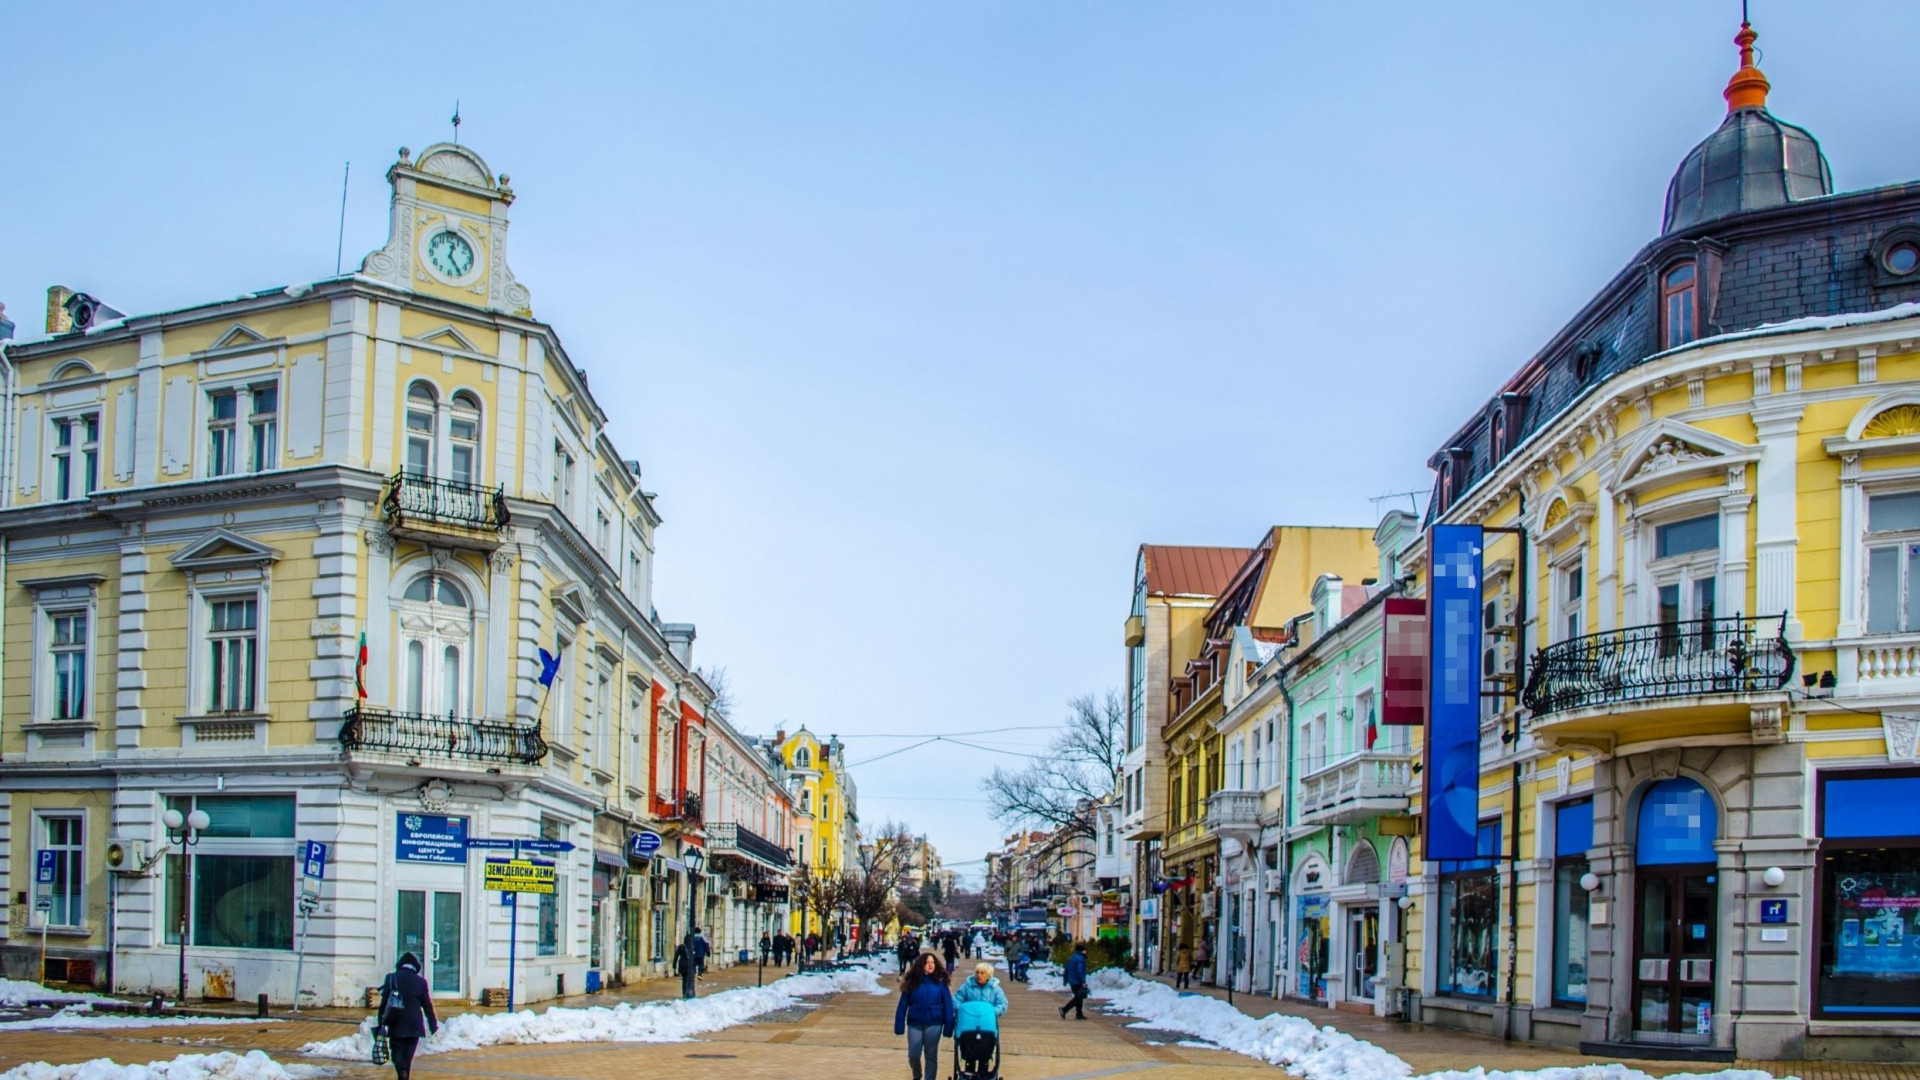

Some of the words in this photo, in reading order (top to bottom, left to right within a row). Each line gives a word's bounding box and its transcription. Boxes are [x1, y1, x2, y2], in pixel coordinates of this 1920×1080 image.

[461, 246, 468, 254] 2
[432, 258, 438, 266] 8
[467, 256, 472, 264] 3
[410, 832, 454, 840] ЕВРОПЕЙСКИ
[402, 838, 462, 848] ИНФОРМАЦИОНЕН
[311, 843, 321, 858] P
[42, 852, 52, 866] P
[488, 864, 534, 876] ЗЕМЕДЕЛСКИ
[534, 867, 554, 878] ЗЕМИ
